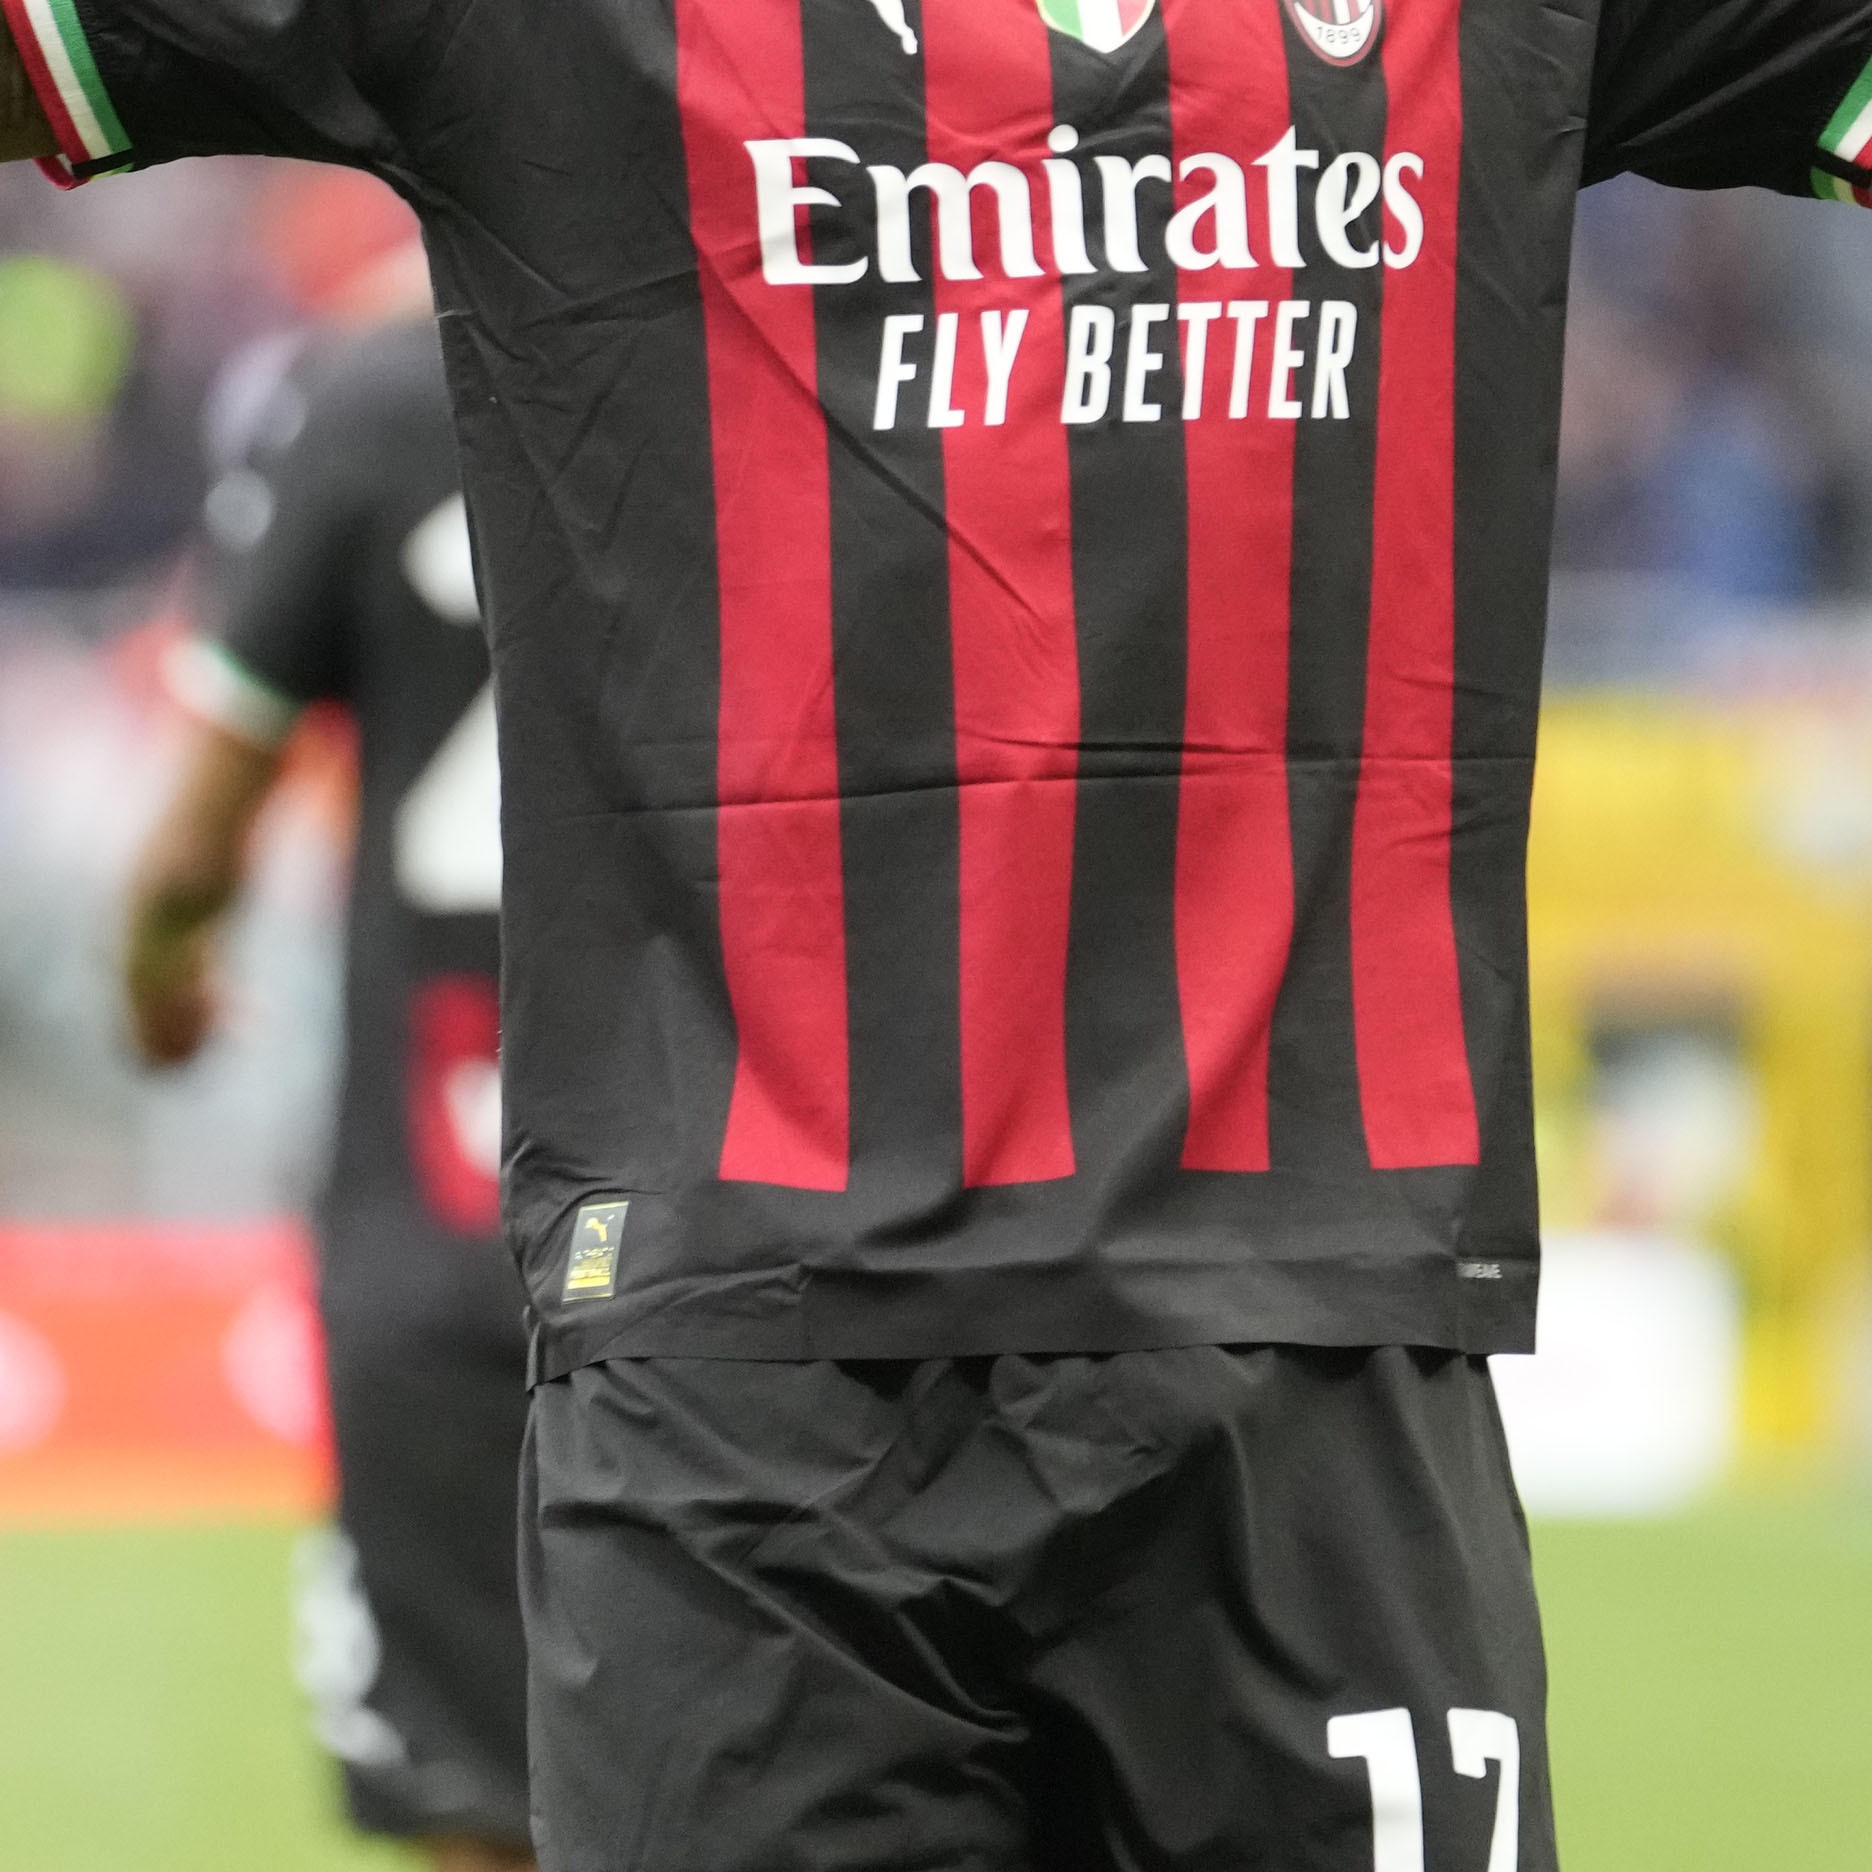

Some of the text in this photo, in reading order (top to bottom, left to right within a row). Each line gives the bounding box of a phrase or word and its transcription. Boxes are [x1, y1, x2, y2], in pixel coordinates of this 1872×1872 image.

[1316, 25, 1363, 46] 1899
[743, 124, 1425, 286] Emirates
[873, 300, 1358, 431] FLY BETTER
[1327, 1706, 1520, 1872] 17
